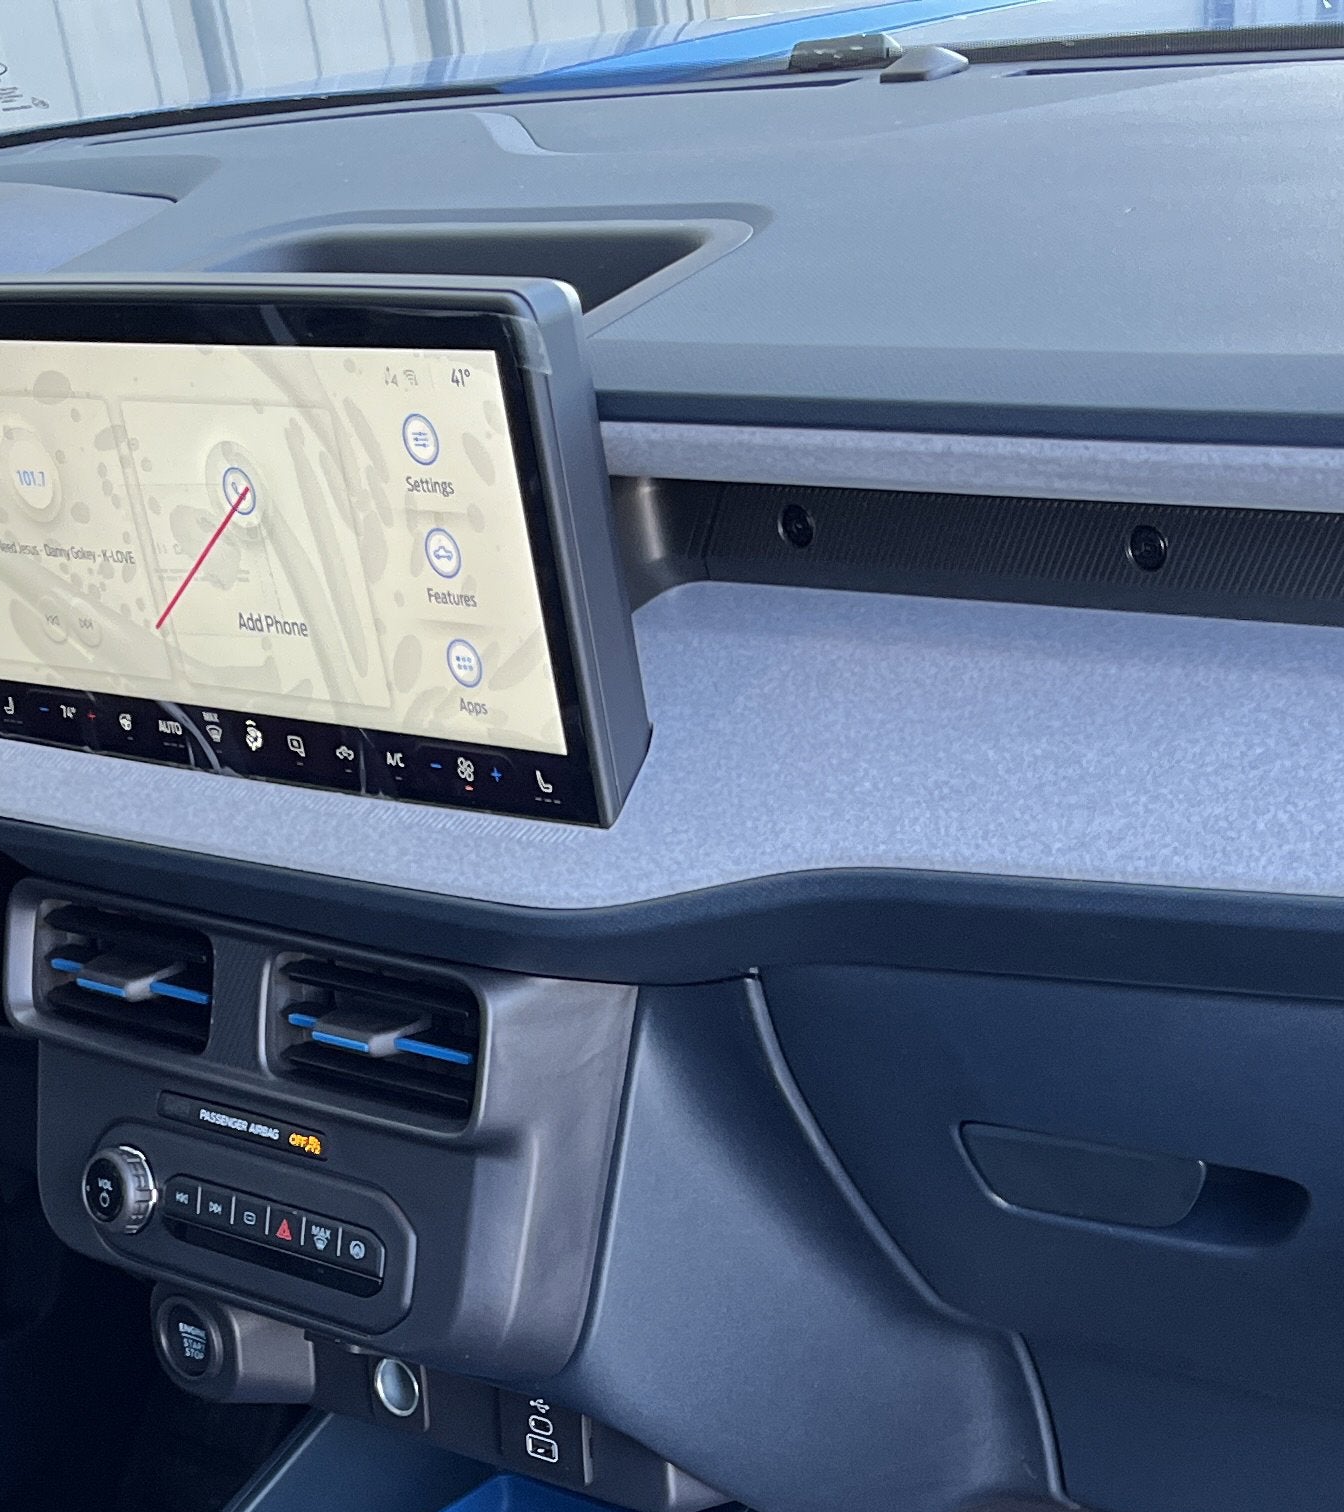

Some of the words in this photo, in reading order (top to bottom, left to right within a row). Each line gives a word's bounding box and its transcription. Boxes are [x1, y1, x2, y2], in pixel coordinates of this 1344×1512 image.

[16, 470, 46, 487] 101.7
[406, 476, 455, 497] Settings
[101, 549, 136, 565] K-LOVE
[426, 587, 478, 608] Features
[238, 611, 264, 633] Add
[264, 615, 308, 637] Phone
[459, 698, 488, 716] Apps
[158, 719, 183, 736] AUTO
[386, 751, 405, 768] A/C
[199, 1109, 248, 1132] PASSENGER
[248, 1123, 280, 1140] AIRBAG
[288, 1132, 307, 1148] OFF
[97, 1177, 113, 1191] VOL
[311, 1224, 332, 1239] MAX
[185, 1347, 205, 1360] STOP
